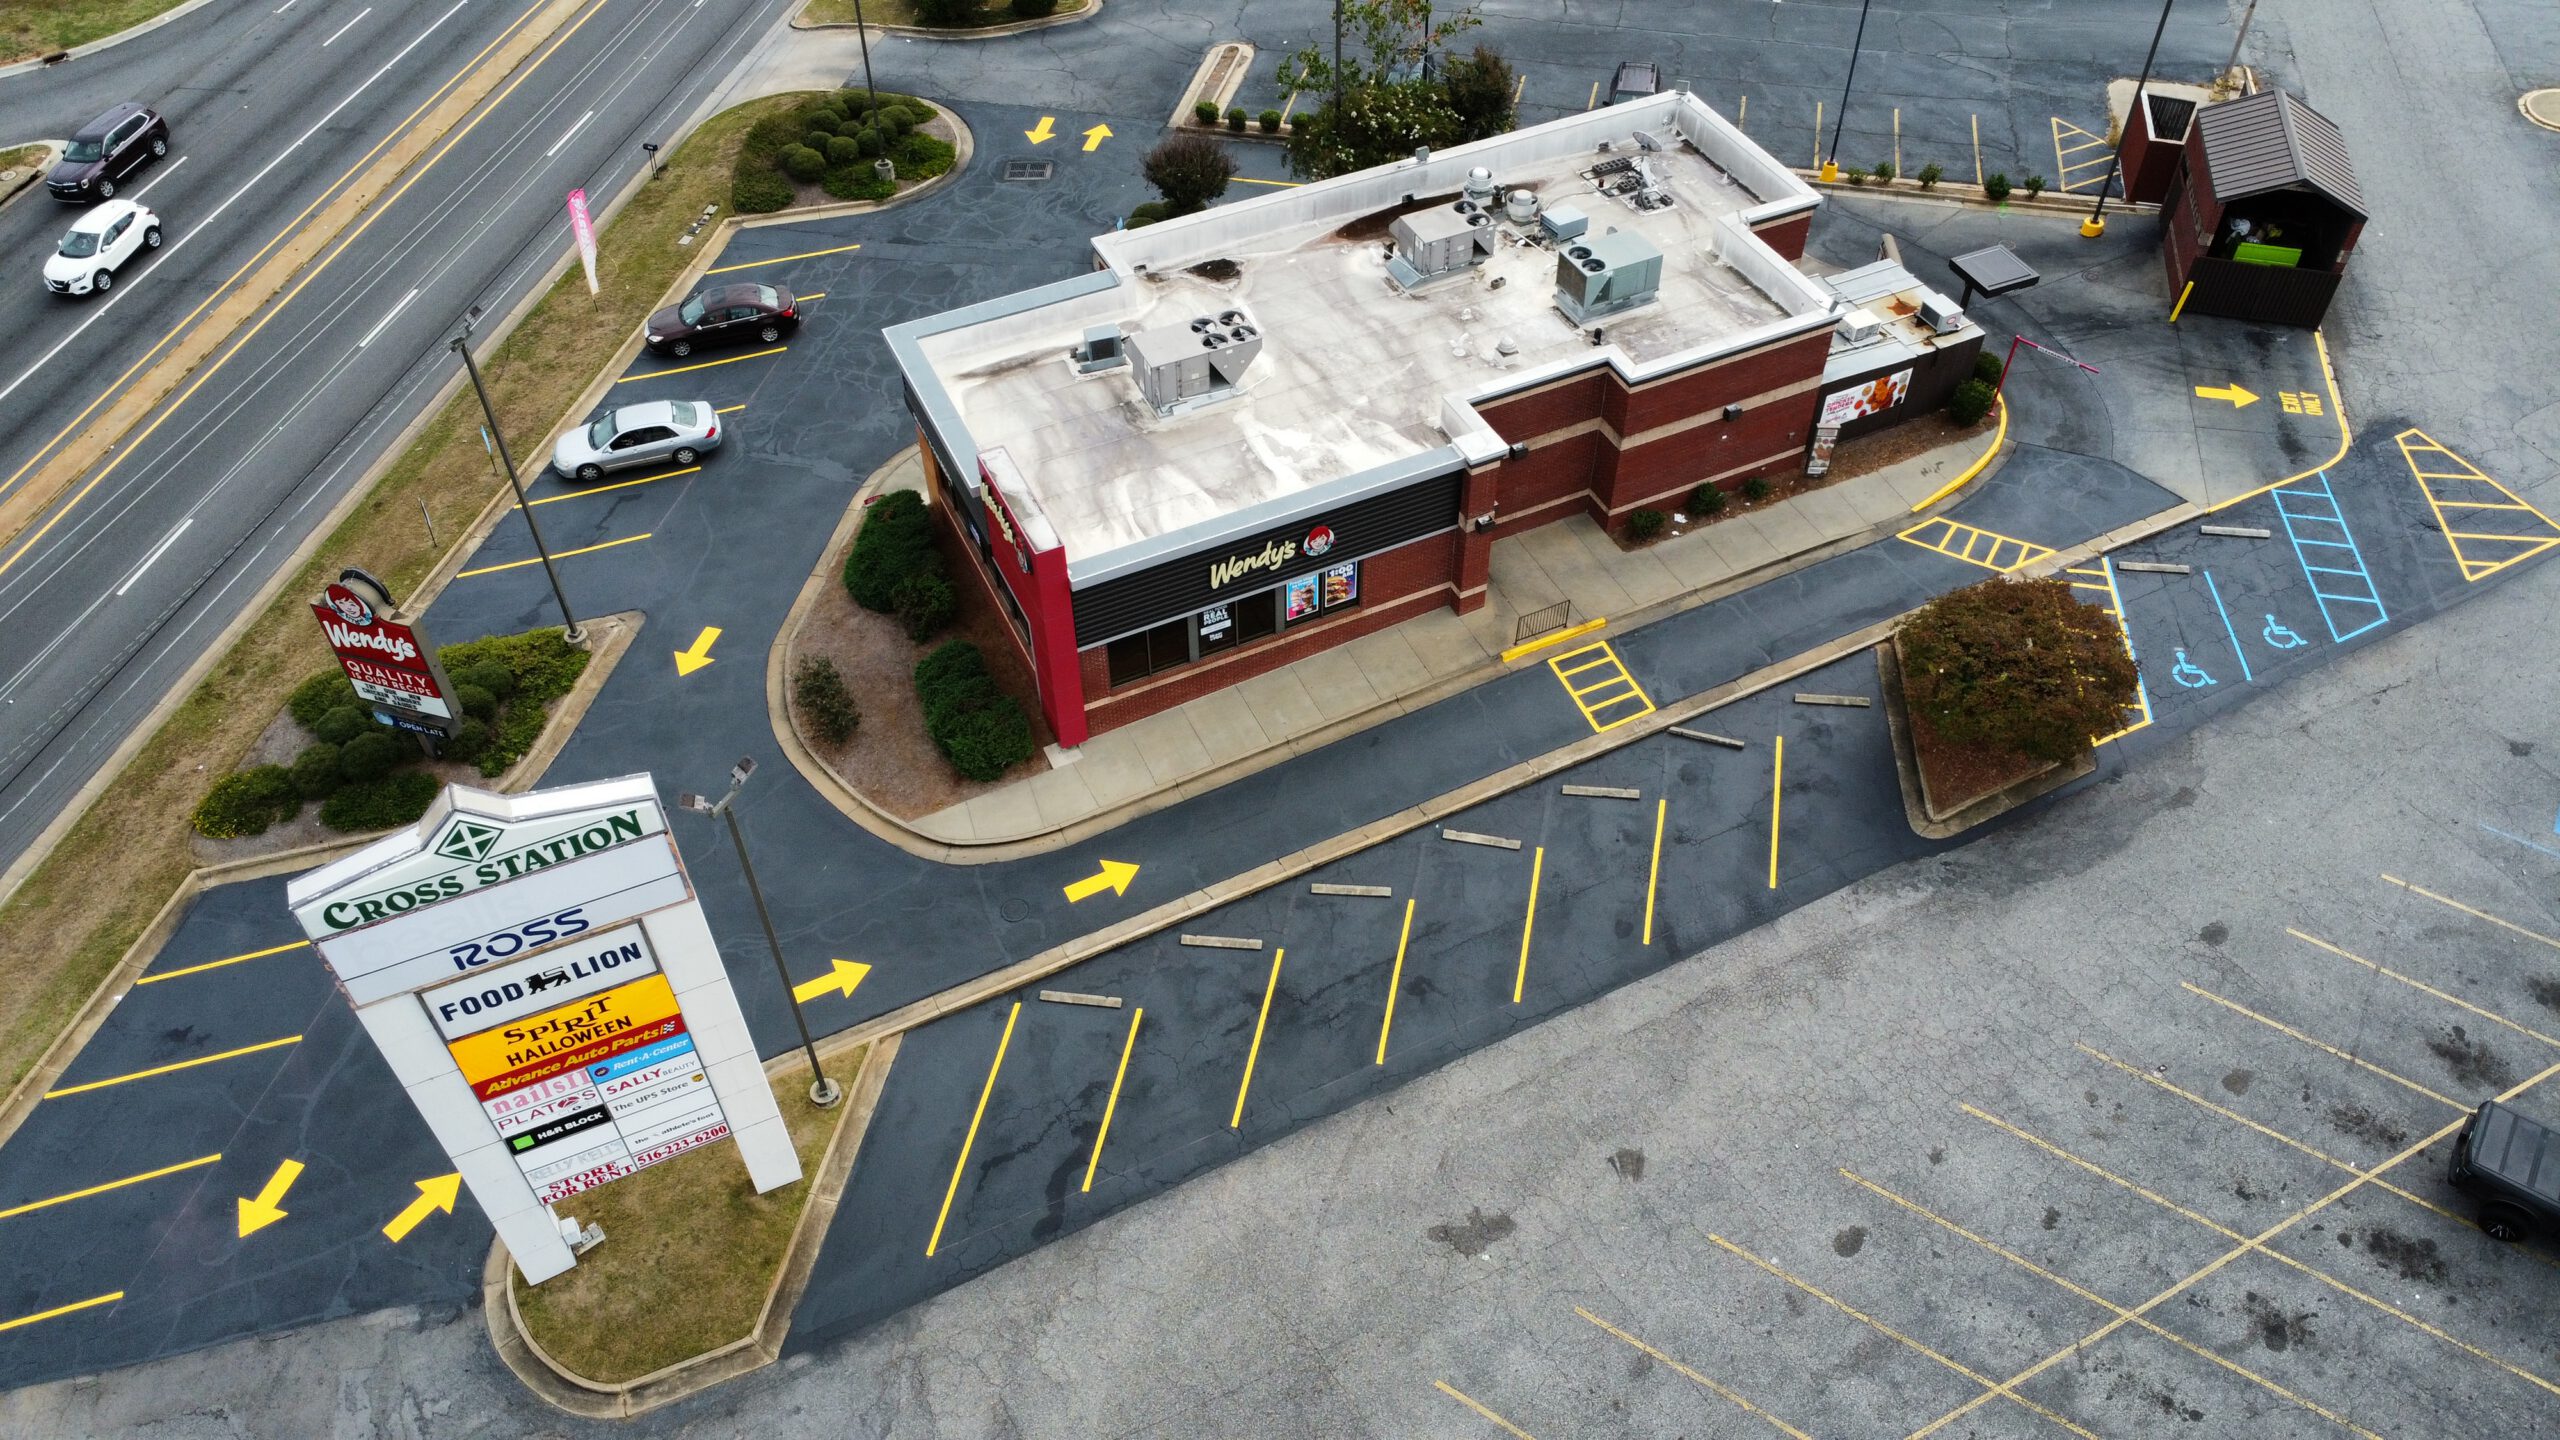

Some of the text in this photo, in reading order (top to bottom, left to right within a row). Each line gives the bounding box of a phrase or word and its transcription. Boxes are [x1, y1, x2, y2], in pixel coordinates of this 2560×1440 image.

[2278, 391, 2303, 414] EXIT
[2300, 391, 2324, 416] ONLY
[1210, 540, 1296, 590] Wendy's
[1329, 564, 1354, 578] 1:00
[1204, 608, 1228, 620] REAL
[1204, 615, 1229, 626] PEOPLE
[322, 620, 417, 662] Wendy's
[346, 660, 427, 688] QUALITY
[351, 671, 433, 697] IS OUR RECIPE
[399, 720, 445, 738] OPEN LATE
[323, 810, 645, 930] CROSS STATION
[449, 907, 590, 971] ROSS
[439, 941, 644, 1023] FOOD LION
[503, 996, 613, 1046] SPIRIT
[506, 1015, 632, 1068] HALLOWEEN
[486, 1027, 660, 1096] Advance Auto Parts
[606, 1068, 662, 1096] SALLY
[662, 1060, 696, 1076] BEAUTY
[614, 1101, 634, 1112] The
[636, 1092, 658, 1104] UPS
[660, 1081, 689, 1095] Store
[538, 1111, 604, 1140] H&R BLOCK
[634, 1112, 715, 1144] the athlete's foot
[637, 1125, 728, 1166] 516-223-6200
[541, 1163, 635, 1206] FOR RENT
[548, 1160, 620, 1193] STORE
